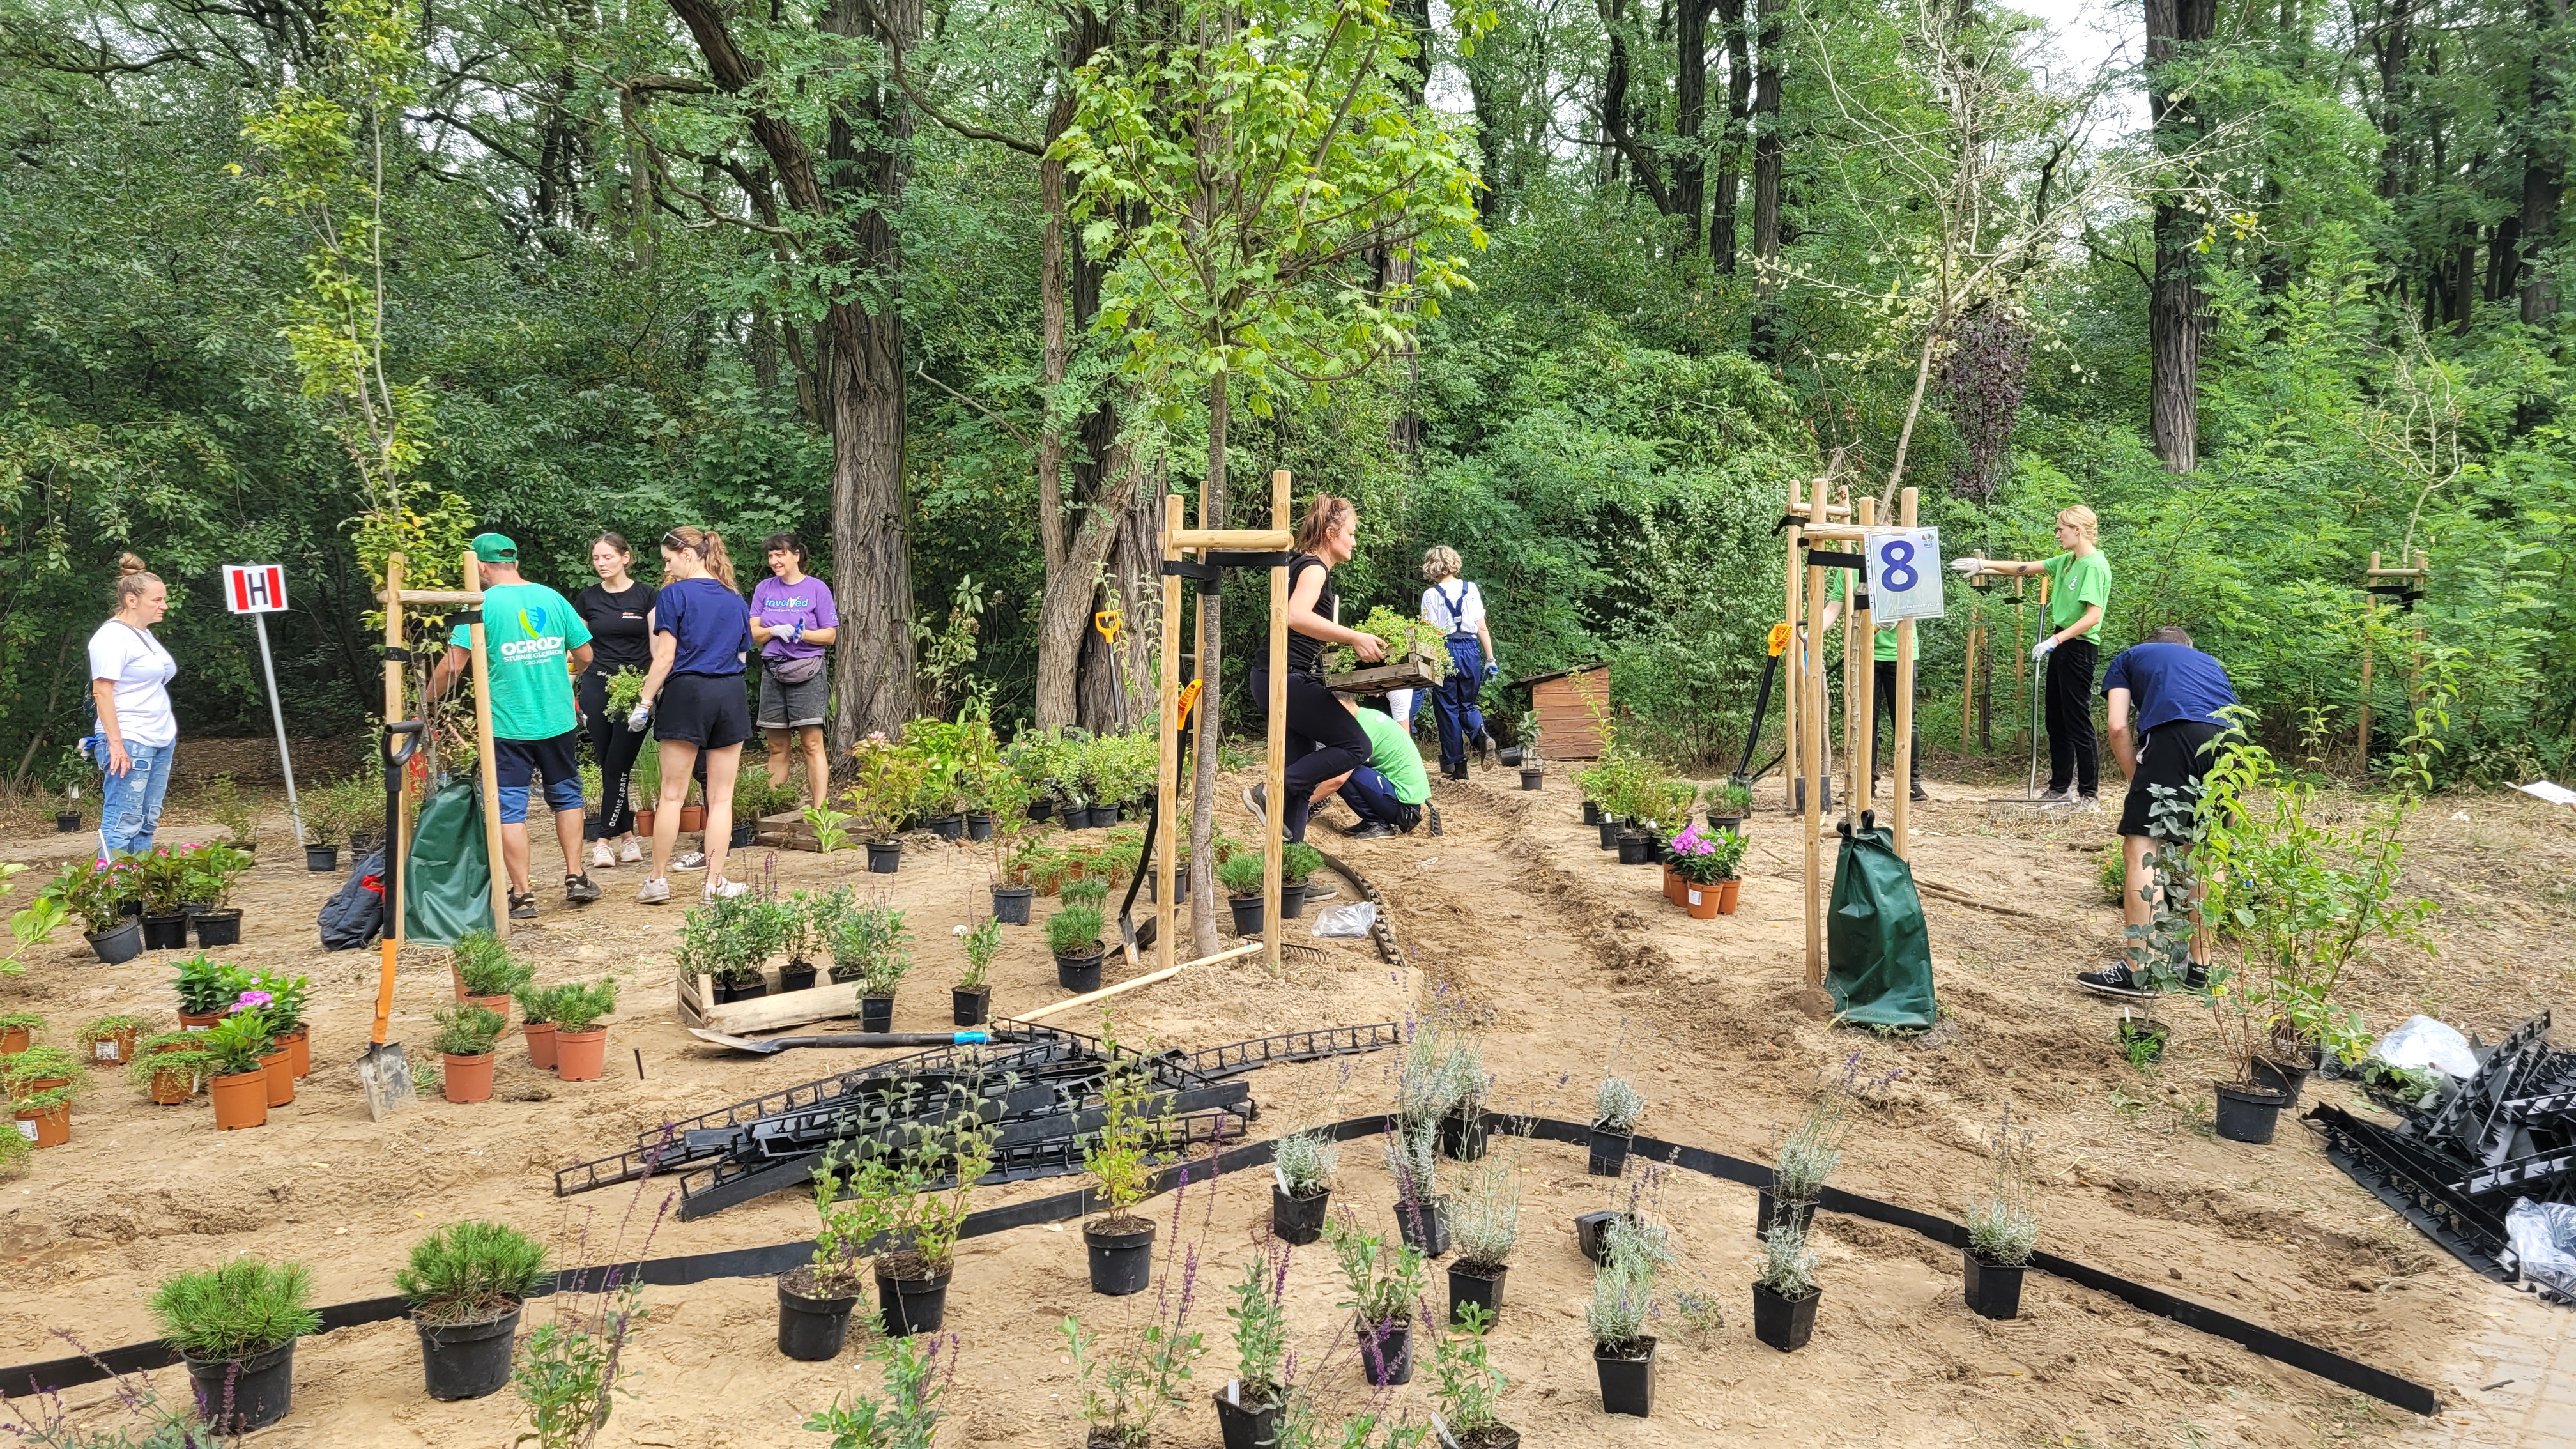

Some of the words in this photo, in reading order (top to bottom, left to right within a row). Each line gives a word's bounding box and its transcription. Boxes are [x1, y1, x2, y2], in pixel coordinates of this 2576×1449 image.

[246, 572, 269, 606] H
[1880, 540, 1919, 592] 8
[609, 799, 624, 827] OCEANS
[618, 772, 628, 798] APART
